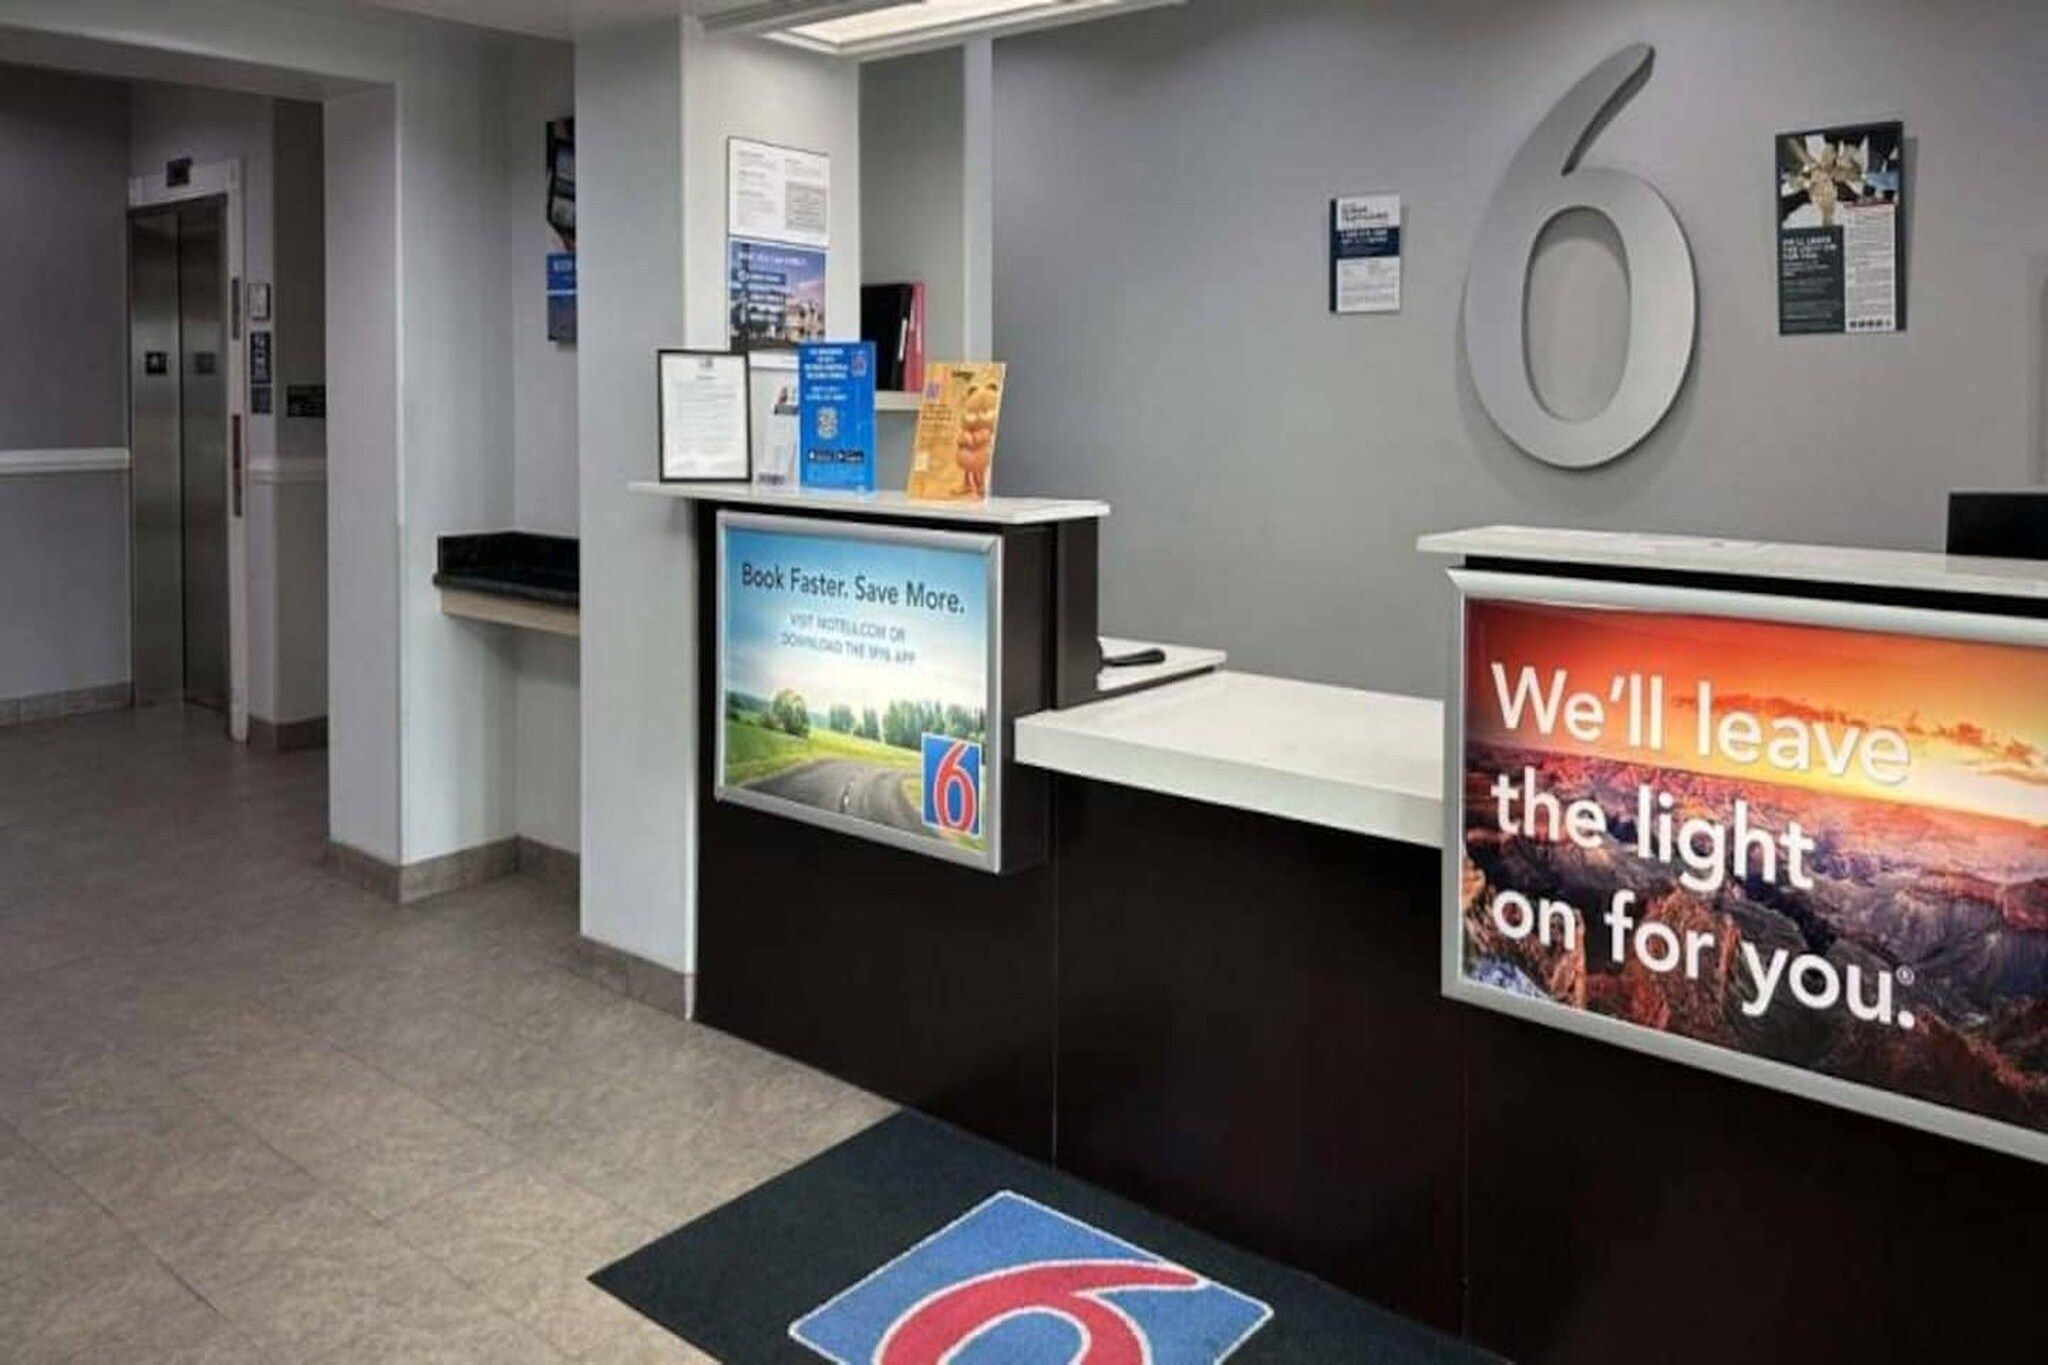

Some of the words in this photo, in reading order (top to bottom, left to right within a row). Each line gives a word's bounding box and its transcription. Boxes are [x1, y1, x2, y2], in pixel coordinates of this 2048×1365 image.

[1464, 42, 1697, 468] 6
[742, 561, 784, 589] Book
[791, 566, 849, 599] Faster.
[855, 575, 899, 605] Save
[906, 580, 964, 614] More.
[1491, 662, 1664, 751] We'll
[1697, 681, 1911, 784] leave
[933, 738, 977, 834] 6
[1490, 766, 1607, 848] the
[1637, 784, 1815, 893] light
[1491, 889, 1577, 951] on
[1604, 890, 1714, 979] for
